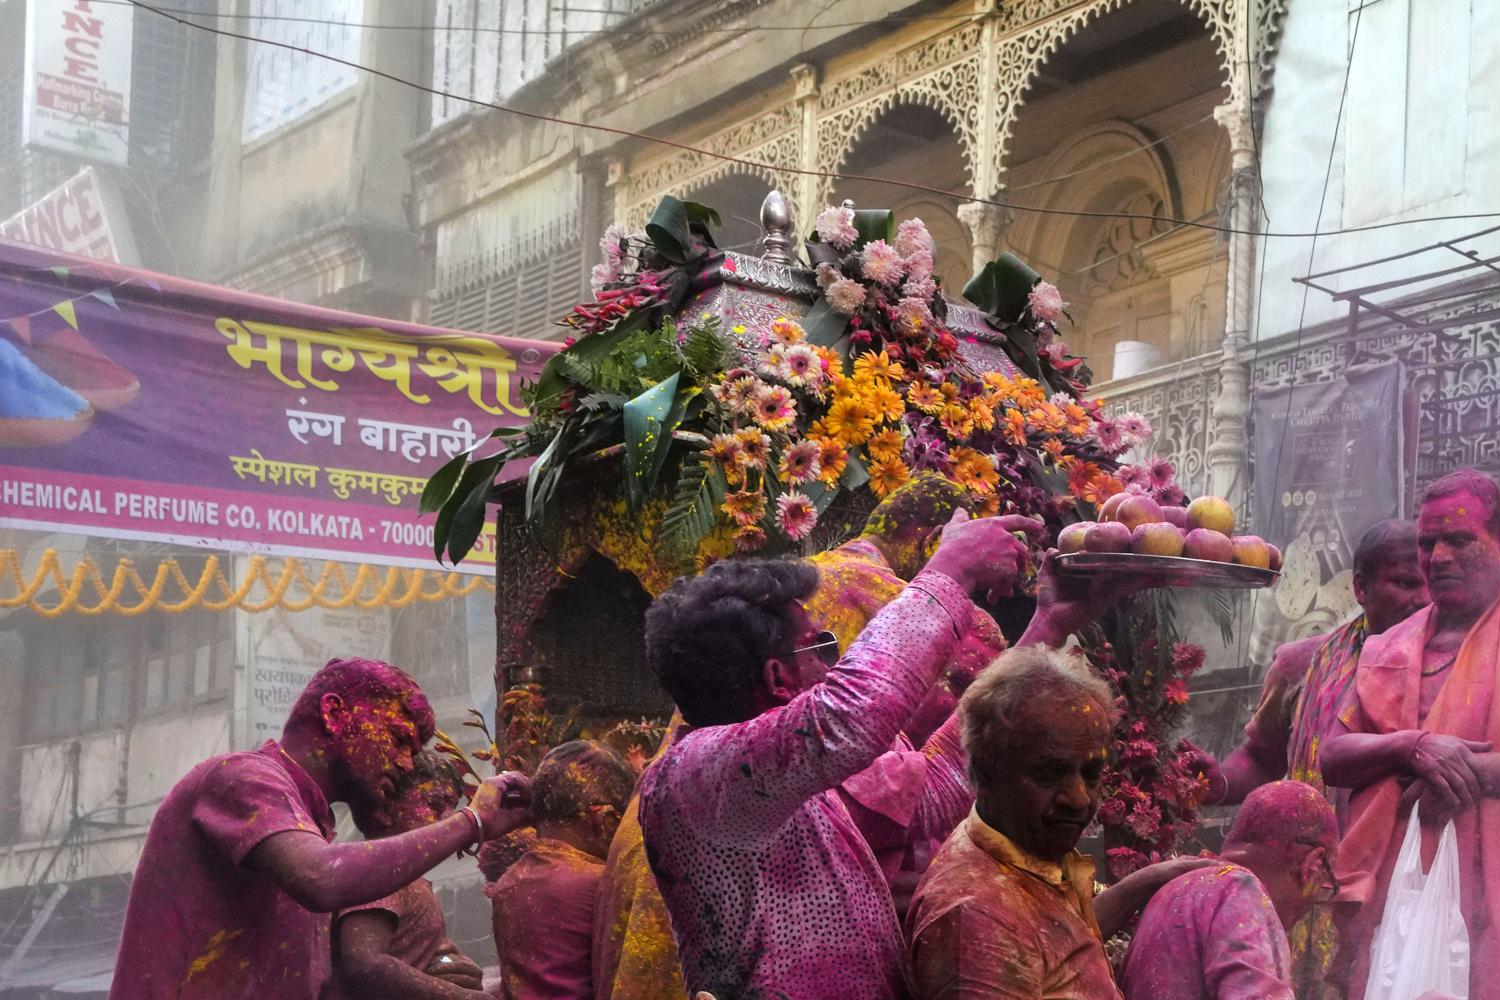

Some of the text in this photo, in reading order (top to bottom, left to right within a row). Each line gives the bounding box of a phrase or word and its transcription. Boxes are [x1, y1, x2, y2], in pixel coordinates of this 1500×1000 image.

[214, 317, 531, 417] भाग्यश्री
[286, 396, 475, 464] रंग बाहारी
[229, 449, 320, 488] स्पेशल
[0, 480, 107, 514] HEMICAL
[115, 492, 219, 526] PERFUME
[226, 505, 260, 530] CO.
[268, 509, 363, 540] KOLKATA
[381, 521, 435, 548] 70000
